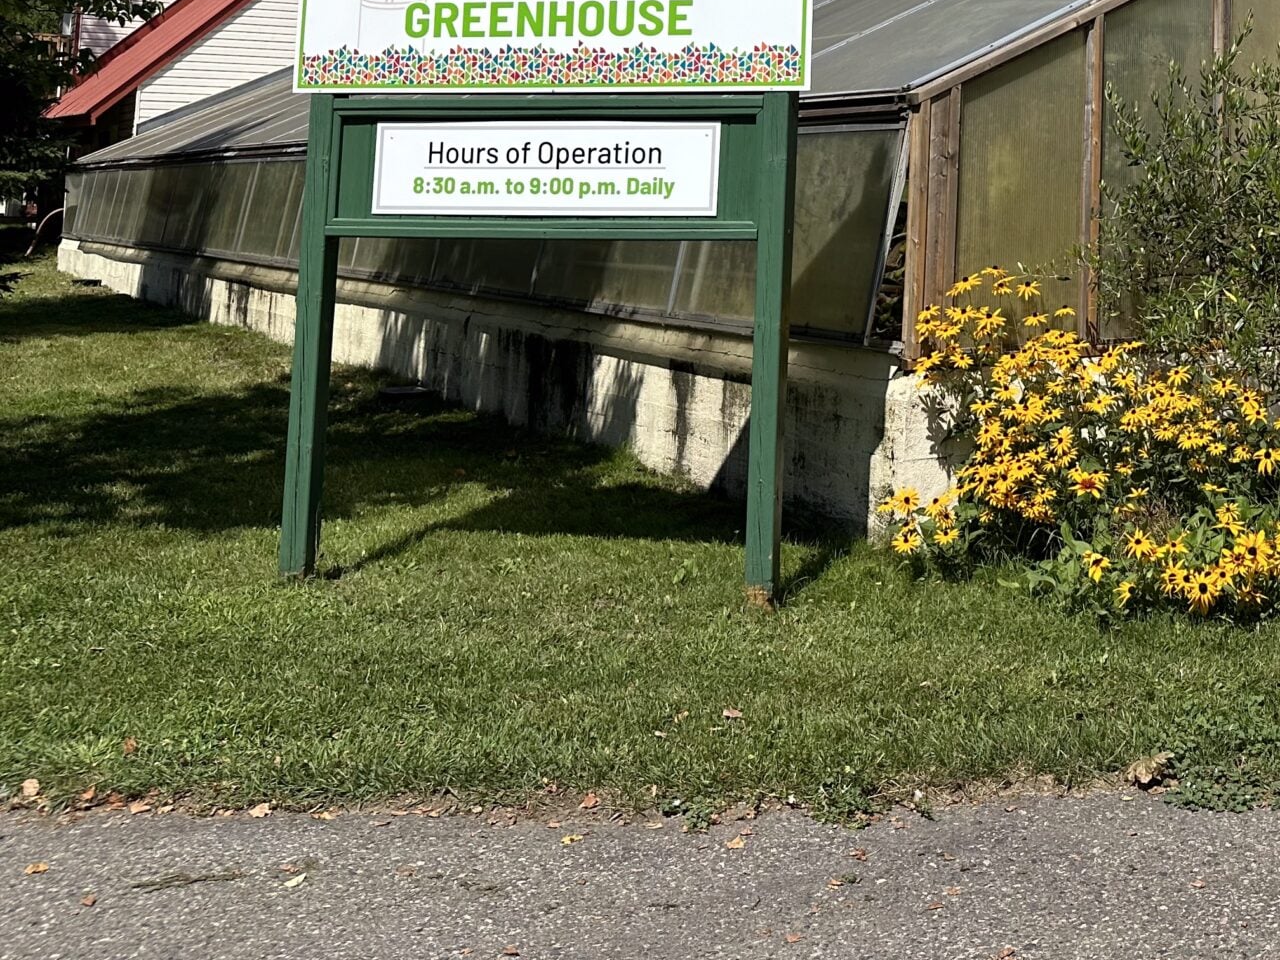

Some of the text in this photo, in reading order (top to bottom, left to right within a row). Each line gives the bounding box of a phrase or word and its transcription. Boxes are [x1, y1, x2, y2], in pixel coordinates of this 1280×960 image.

[405, 0, 693, 38] GREENHOUSE
[428, 141, 662, 169] Hours of Operation
[413, 177, 675, 199] 8:30 a.m. to 9:00 p.m. Daily
